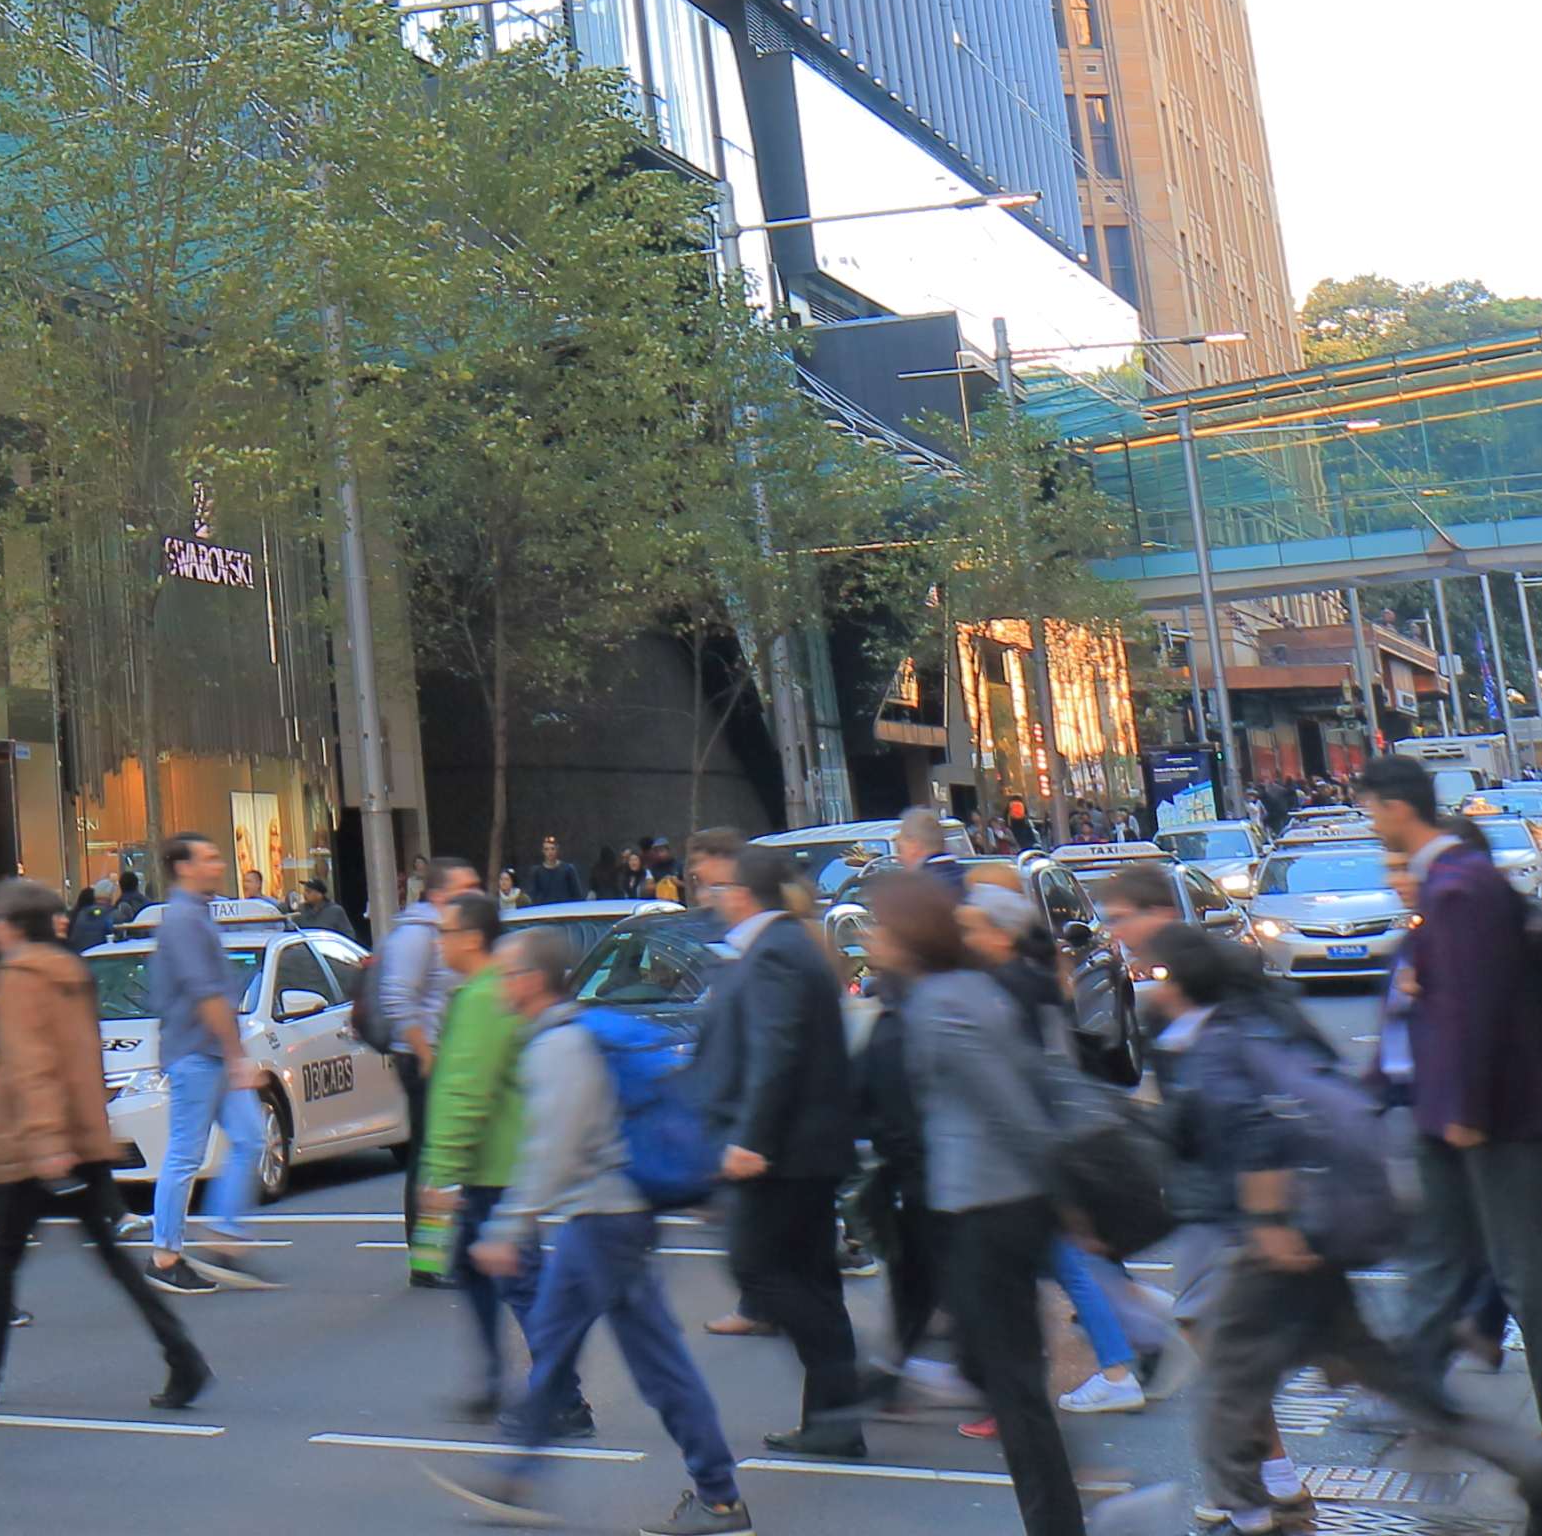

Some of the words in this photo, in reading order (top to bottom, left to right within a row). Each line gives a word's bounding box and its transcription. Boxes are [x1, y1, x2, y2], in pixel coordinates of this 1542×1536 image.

[164, 537, 255, 590] SWAROVSKI
[1090, 847, 1118, 855] TAXI
[213, 903, 240, 916] TAXI
